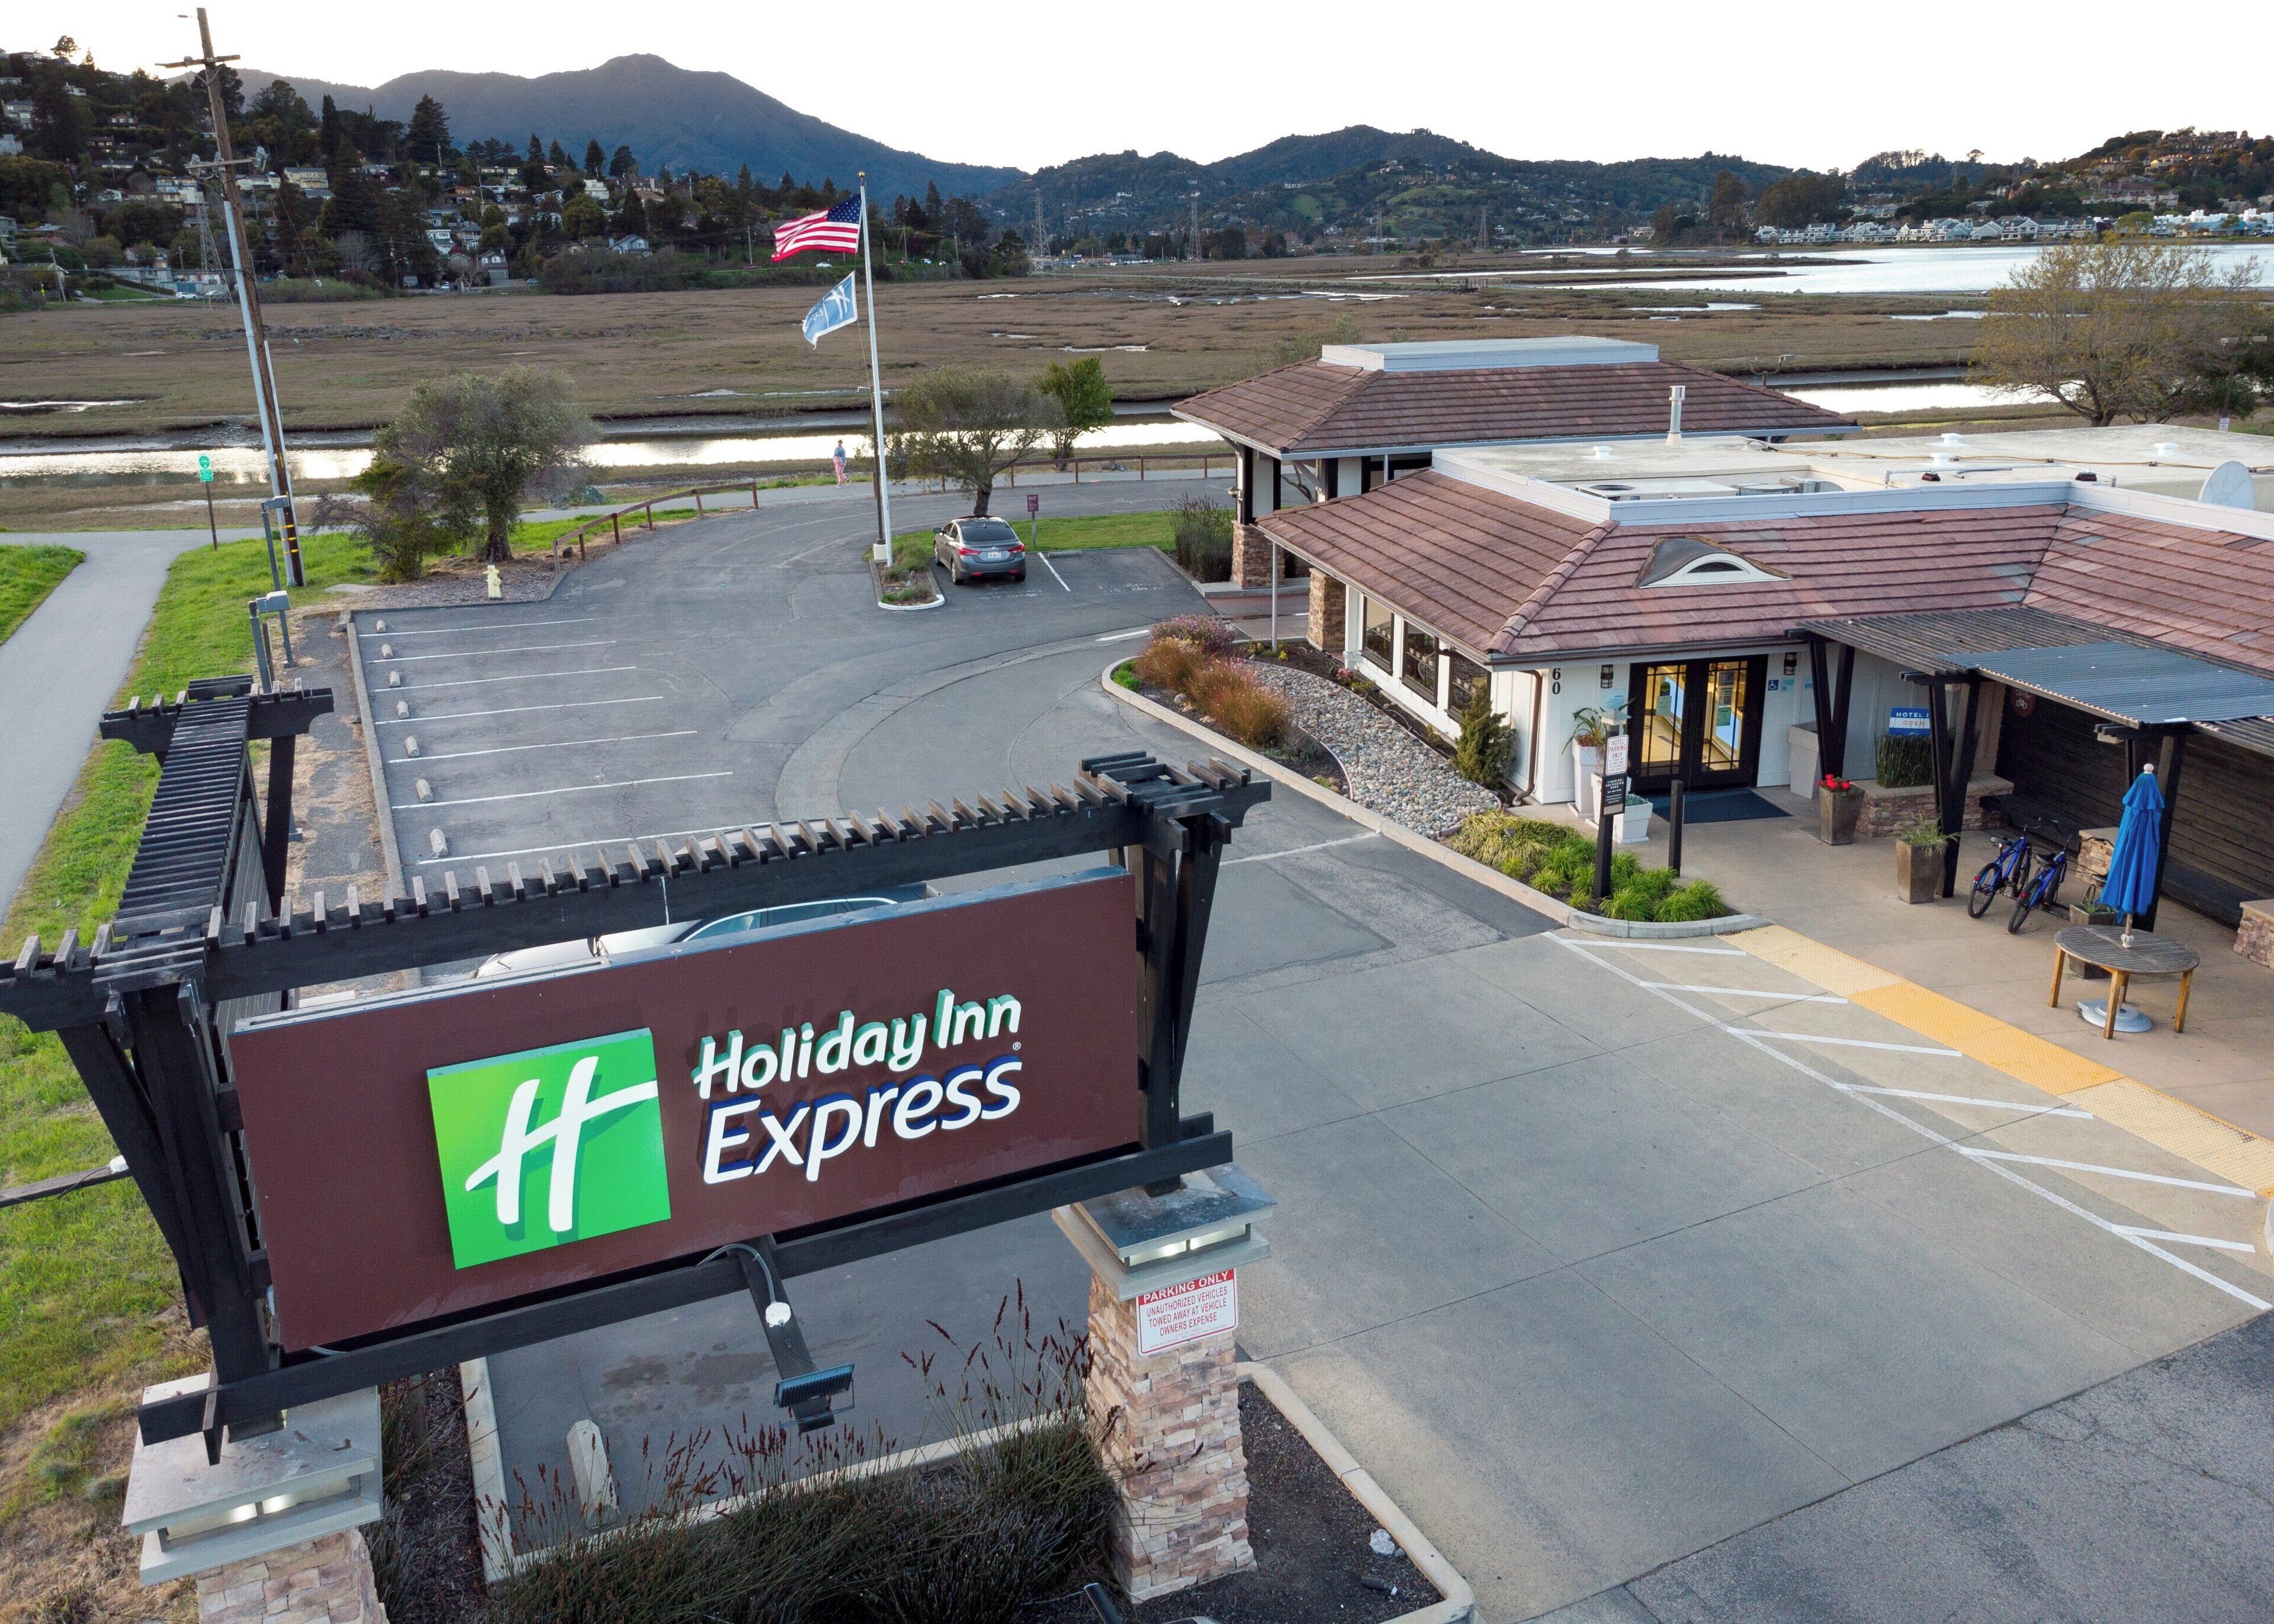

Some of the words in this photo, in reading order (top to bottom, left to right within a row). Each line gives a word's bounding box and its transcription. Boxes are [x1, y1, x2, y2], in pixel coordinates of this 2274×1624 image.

[1552, 668, 1561, 694] 60
[691, 1010, 927, 1099] Holiday
[932, 989, 1022, 1049] Inn
[703, 1055, 1023, 1185] Express
[1144, 1282, 1195, 1304] PARKING
[1199, 1271, 1229, 1287] ONLY
[1146, 1295, 1196, 1317] UNAUTHORIZED
[1197, 1285, 1228, 1303] VEHICLES
[1149, 1314, 1172, 1328] TOWED
[1173, 1309, 1191, 1321] AWAY
[1191, 1305, 1199, 1317] AT
[1200, 1297, 1227, 1314] VEHICLE
[1160, 1321, 1187, 1336] OWNERS
[1189, 1312, 1218, 1328] EXPENSE
